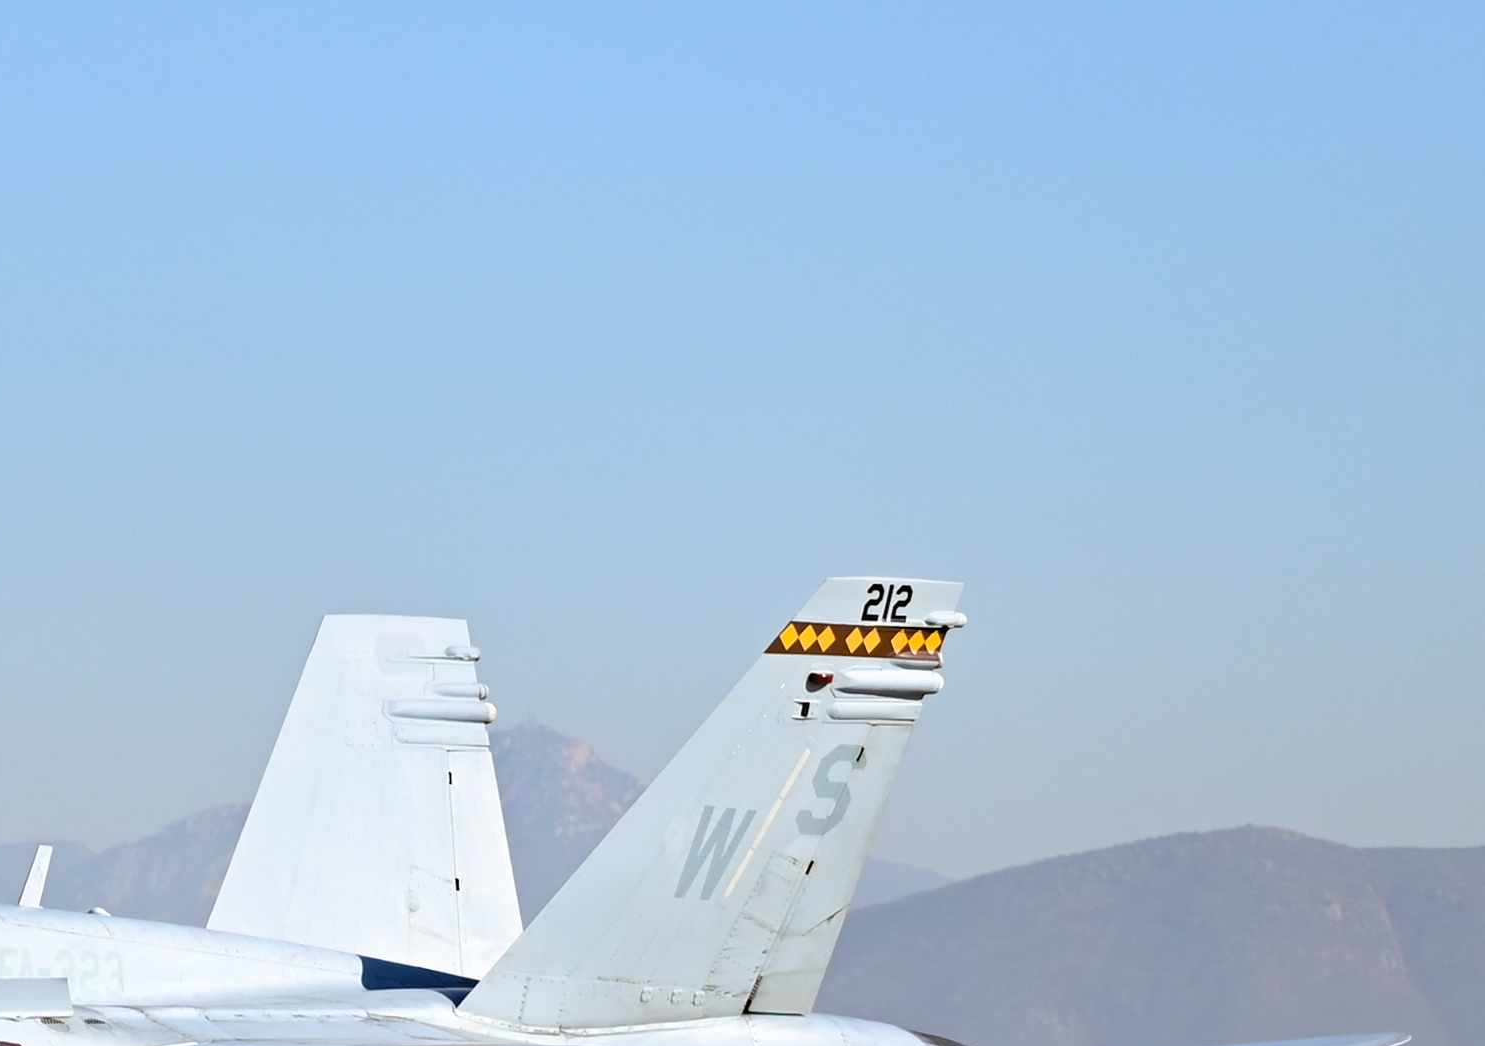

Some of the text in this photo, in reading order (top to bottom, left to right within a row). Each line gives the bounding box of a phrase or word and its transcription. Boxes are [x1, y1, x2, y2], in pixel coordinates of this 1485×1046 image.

[861, 583, 913, 622] 212
[674, 744, 868, 900] W S
